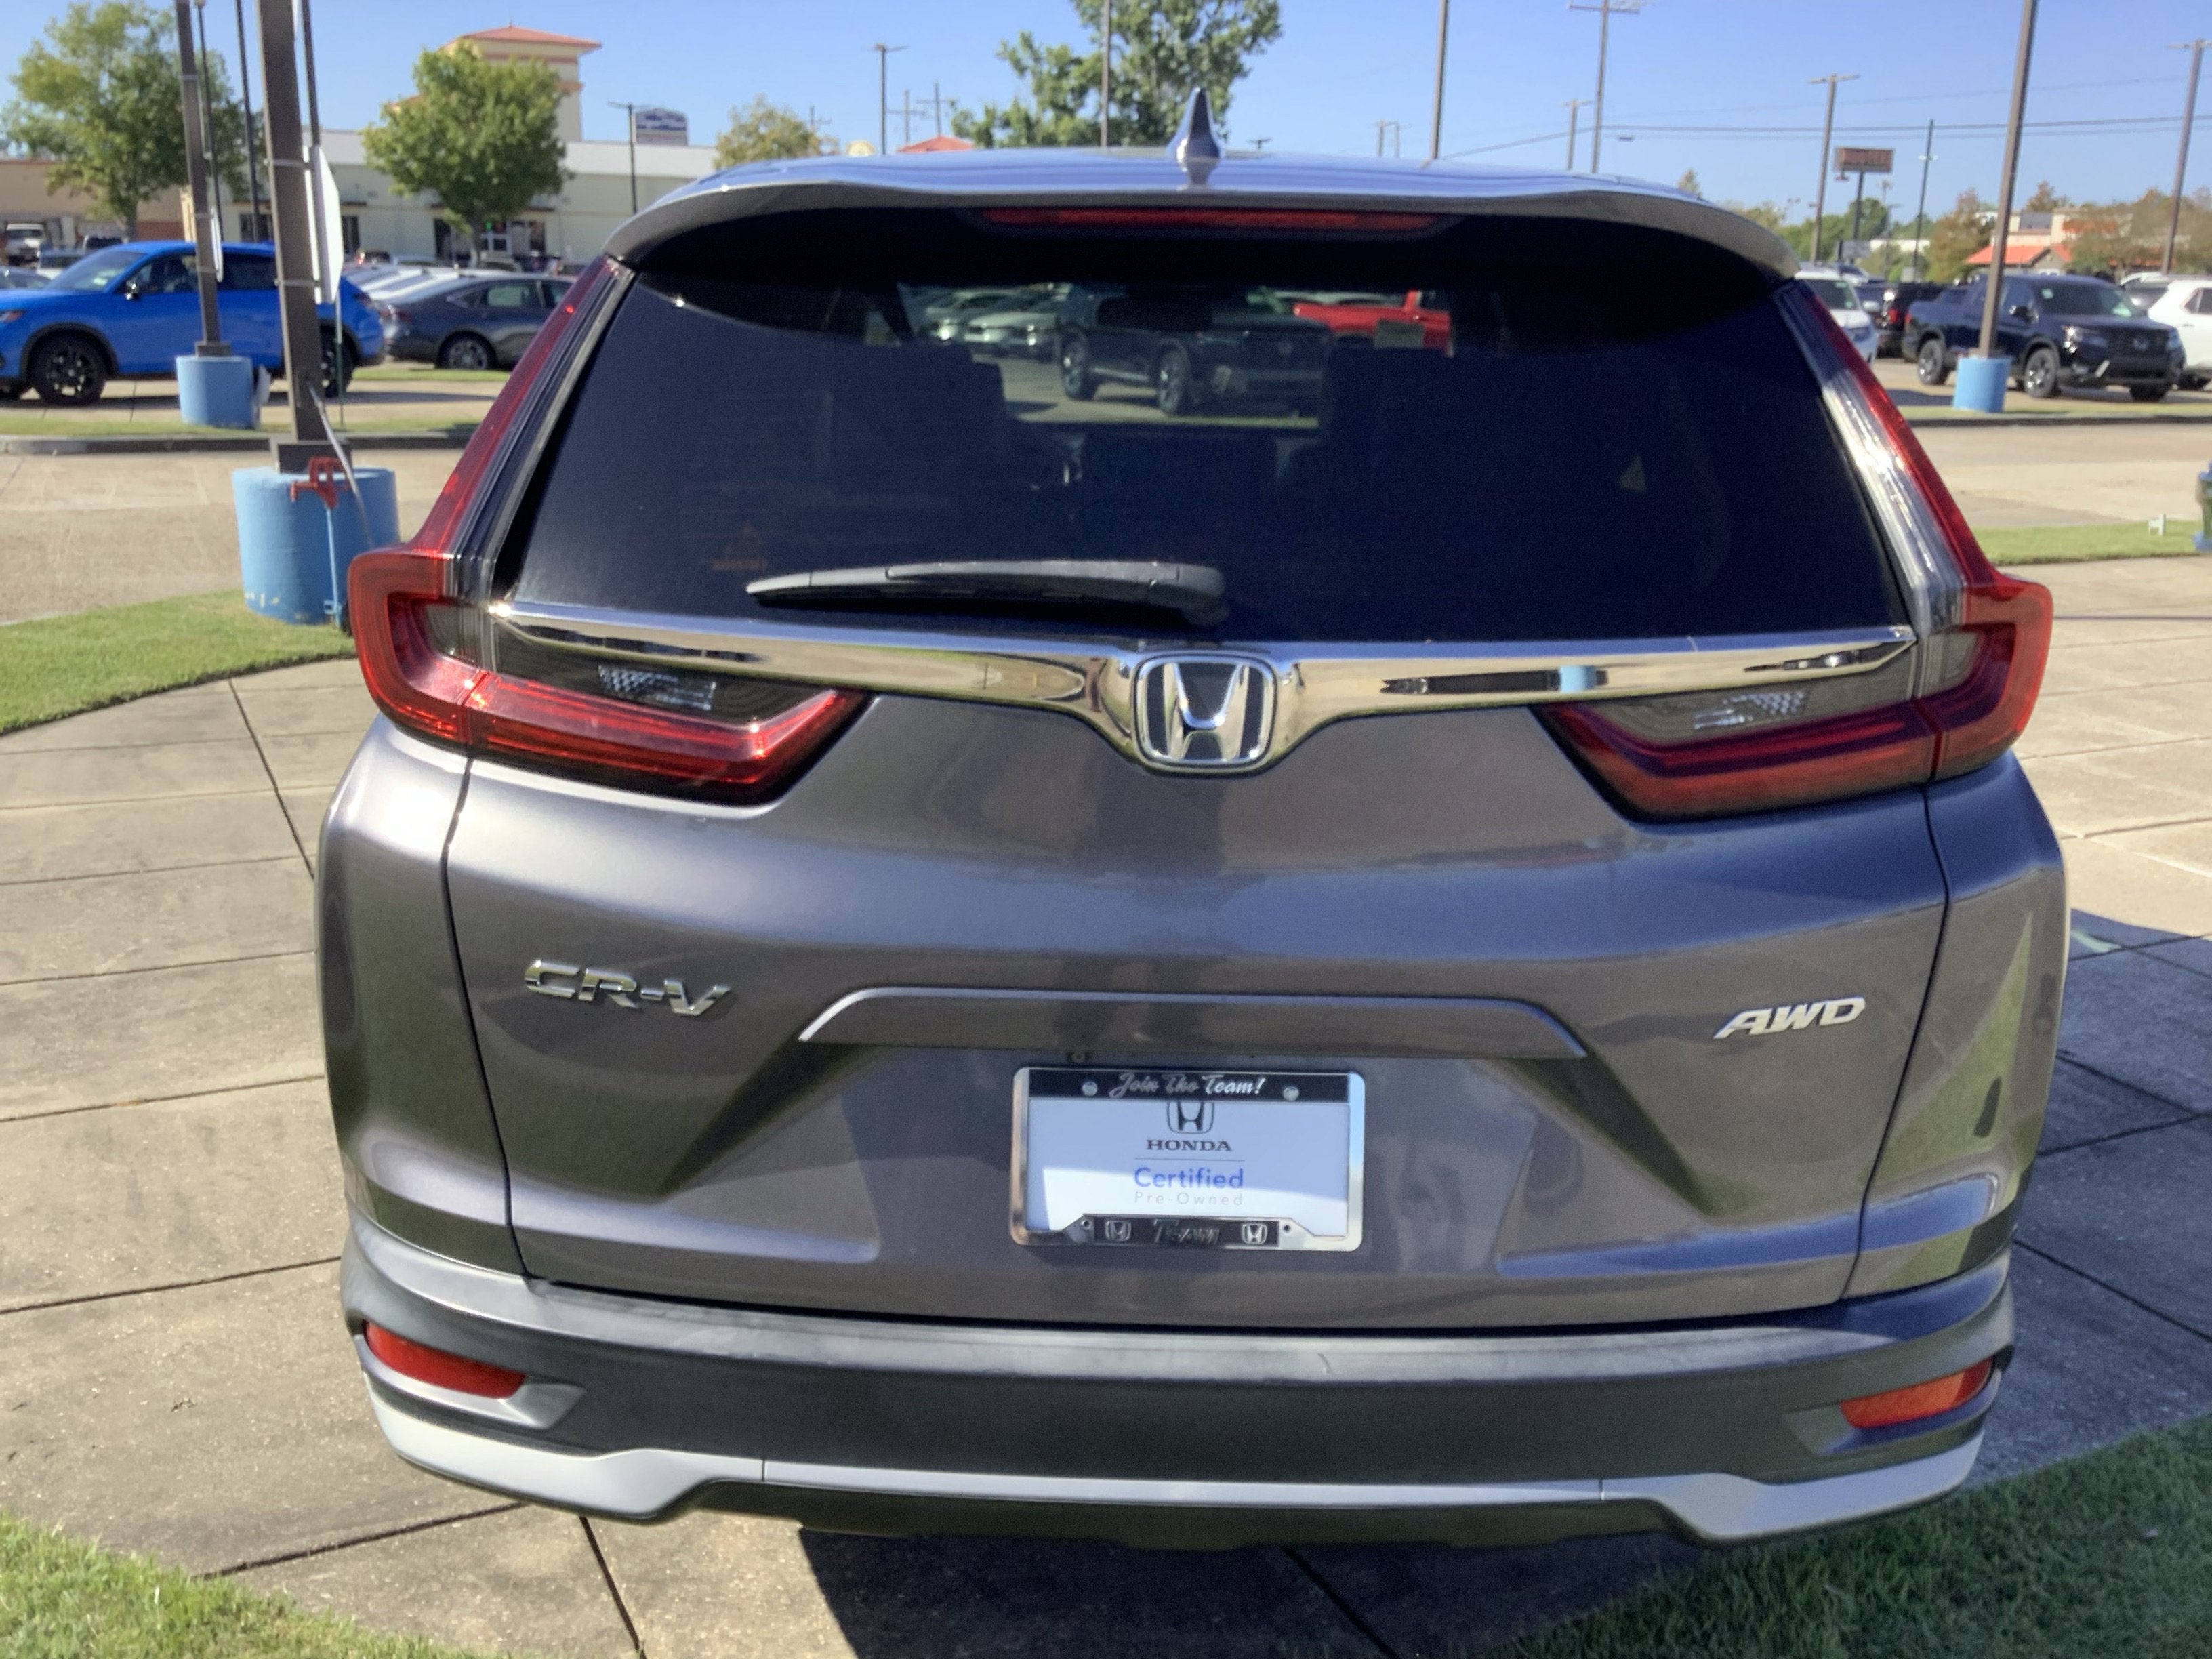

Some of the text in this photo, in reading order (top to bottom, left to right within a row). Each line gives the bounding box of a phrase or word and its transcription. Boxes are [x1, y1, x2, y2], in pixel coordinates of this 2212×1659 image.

[524, 958, 731, 1016] CR-V
[1713, 996, 1865, 1039] AWD
[1109, 1073, 1159, 1098] Join
[1202, 1075, 1266, 1094] Team!
[1146, 1139, 1232, 1151] HONDA
[1134, 1167, 1244, 1188] Certified
[1134, 1191, 1243, 1206] Pre-Owned
